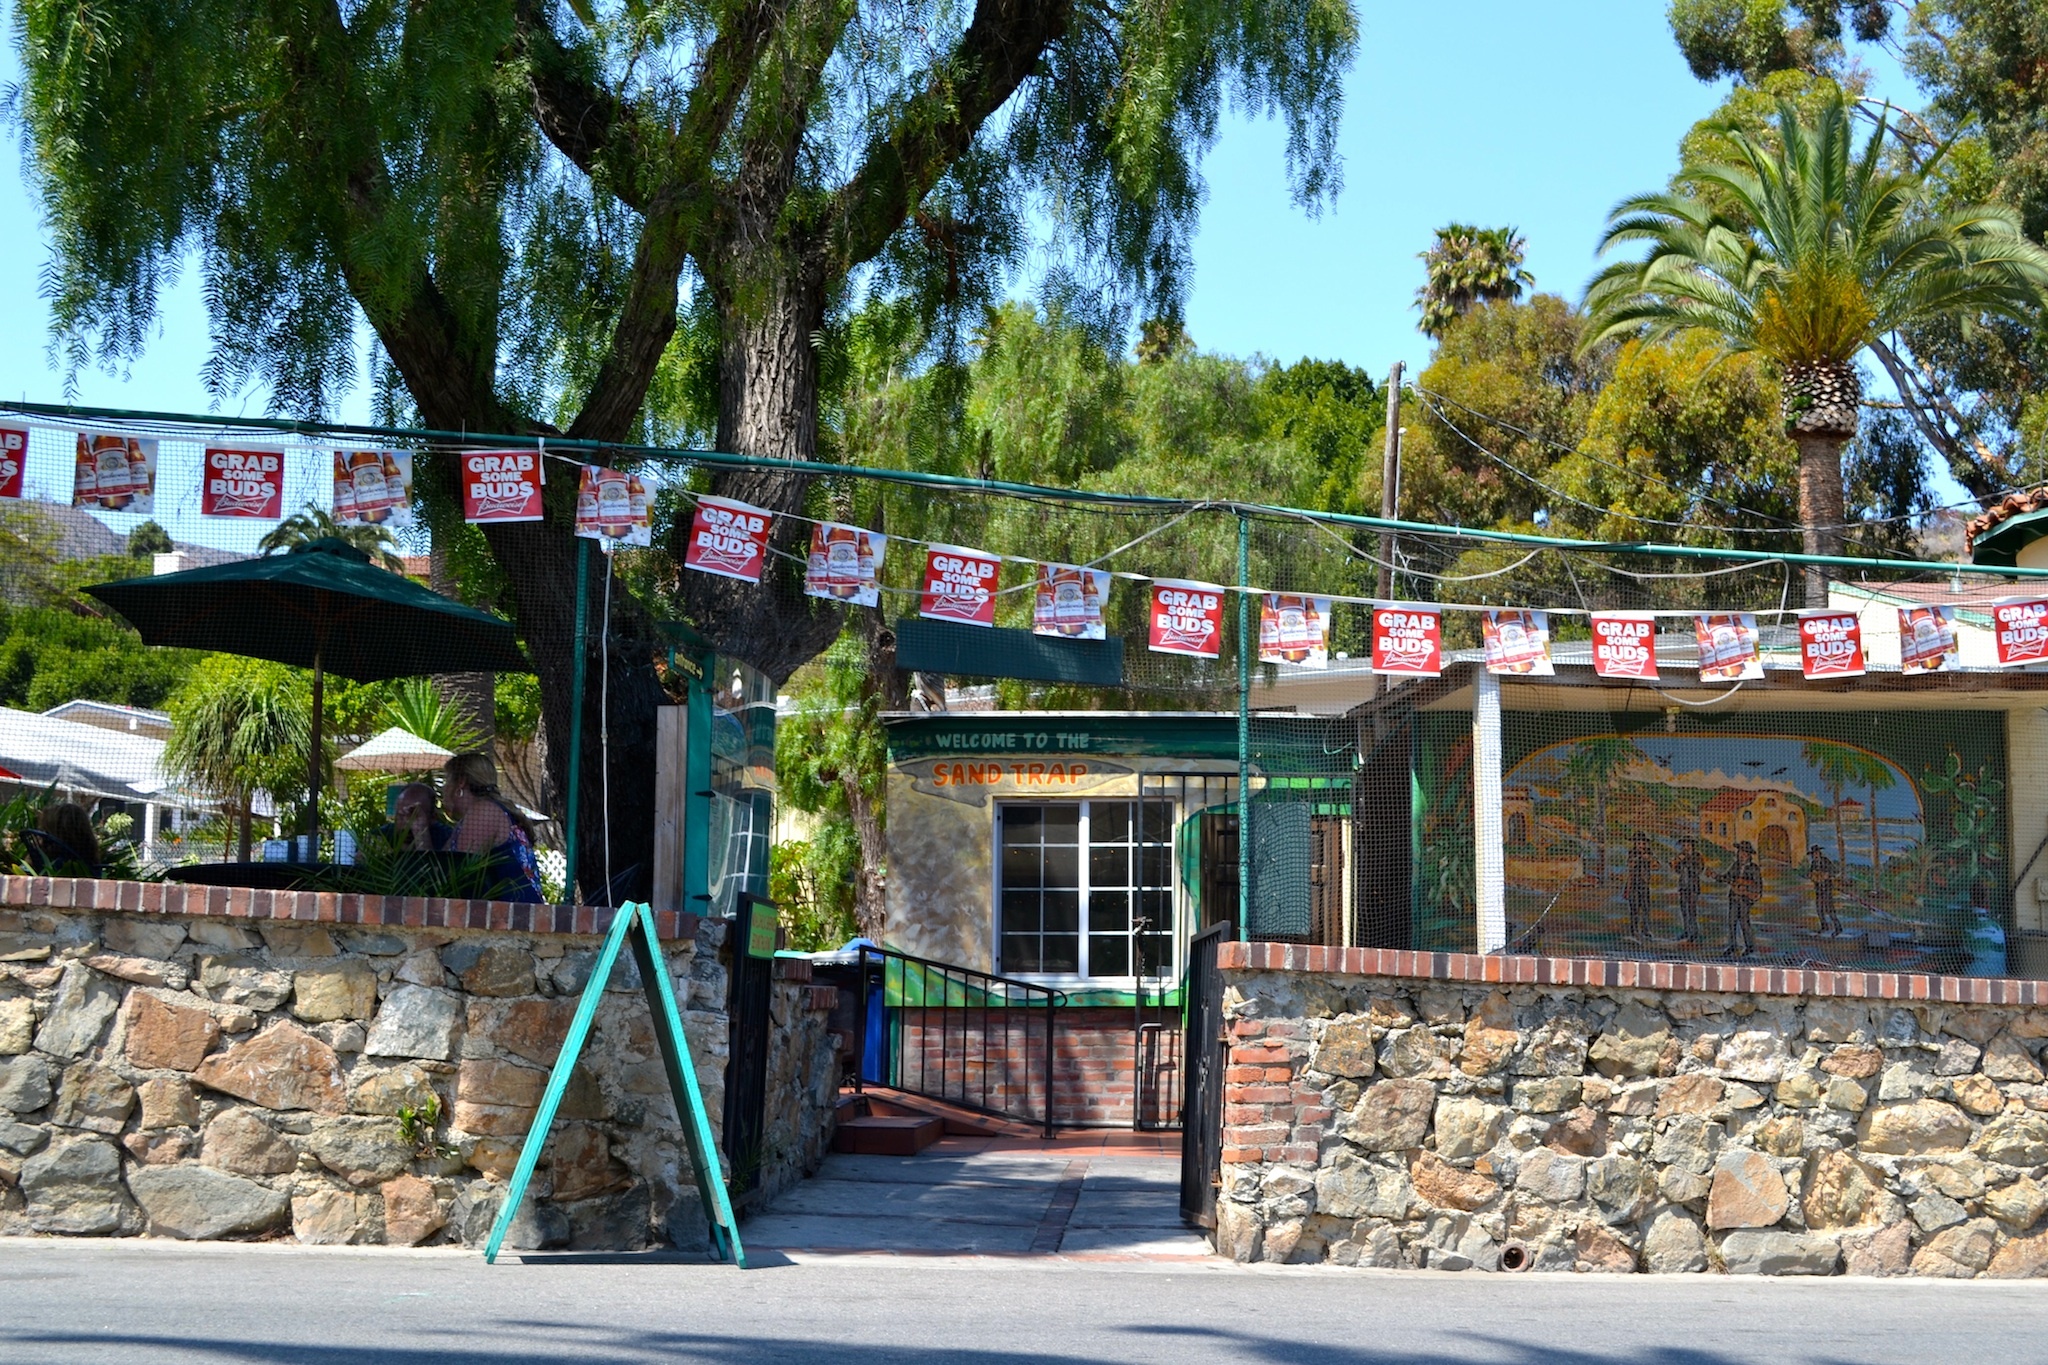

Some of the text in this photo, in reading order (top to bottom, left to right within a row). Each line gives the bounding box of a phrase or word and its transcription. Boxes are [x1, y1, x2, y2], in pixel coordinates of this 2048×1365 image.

[211, 453, 278, 471] GRAB
[468, 456, 533, 472] GRAB
[222, 469, 266, 481] SOME
[481, 472, 523, 482] SOME
[210, 479, 276, 498] BUDS
[470, 481, 534, 498] BUDS
[701, 508, 764, 533] GRAB
[710, 524, 751, 540] SOME
[697, 531, 758, 557] BUDS
[933, 556, 994, 578] GRAB
[942, 572, 981, 586] SOME
[930, 580, 989, 602] BUDS
[1158, 590, 1217, 610] GRAB
[1168, 606, 1206, 618] SOME
[1998, 604, 2047, 622] GRAB
[1157, 614, 1214, 634] BUDS
[1378, 612, 1435, 630] GRAB
[1597, 622, 1649, 637] GRAB
[1804, 617, 1856, 634] GRAB
[2008, 618, 2040, 630] SOME
[1389, 628, 1425, 638] SOME
[1606, 636, 1640, 646] SOME
[1814, 631, 1847, 642] SOME
[2001, 626, 2048, 645] BUDS
[1379, 636, 1434, 654] BUDS
[1598, 645, 1649, 660] BUDS
[1807, 640, 1856, 657] BUDS
[935, 732, 1090, 749] WELCOME TO THE
[932, 762, 1089, 787] SAND TRAP
